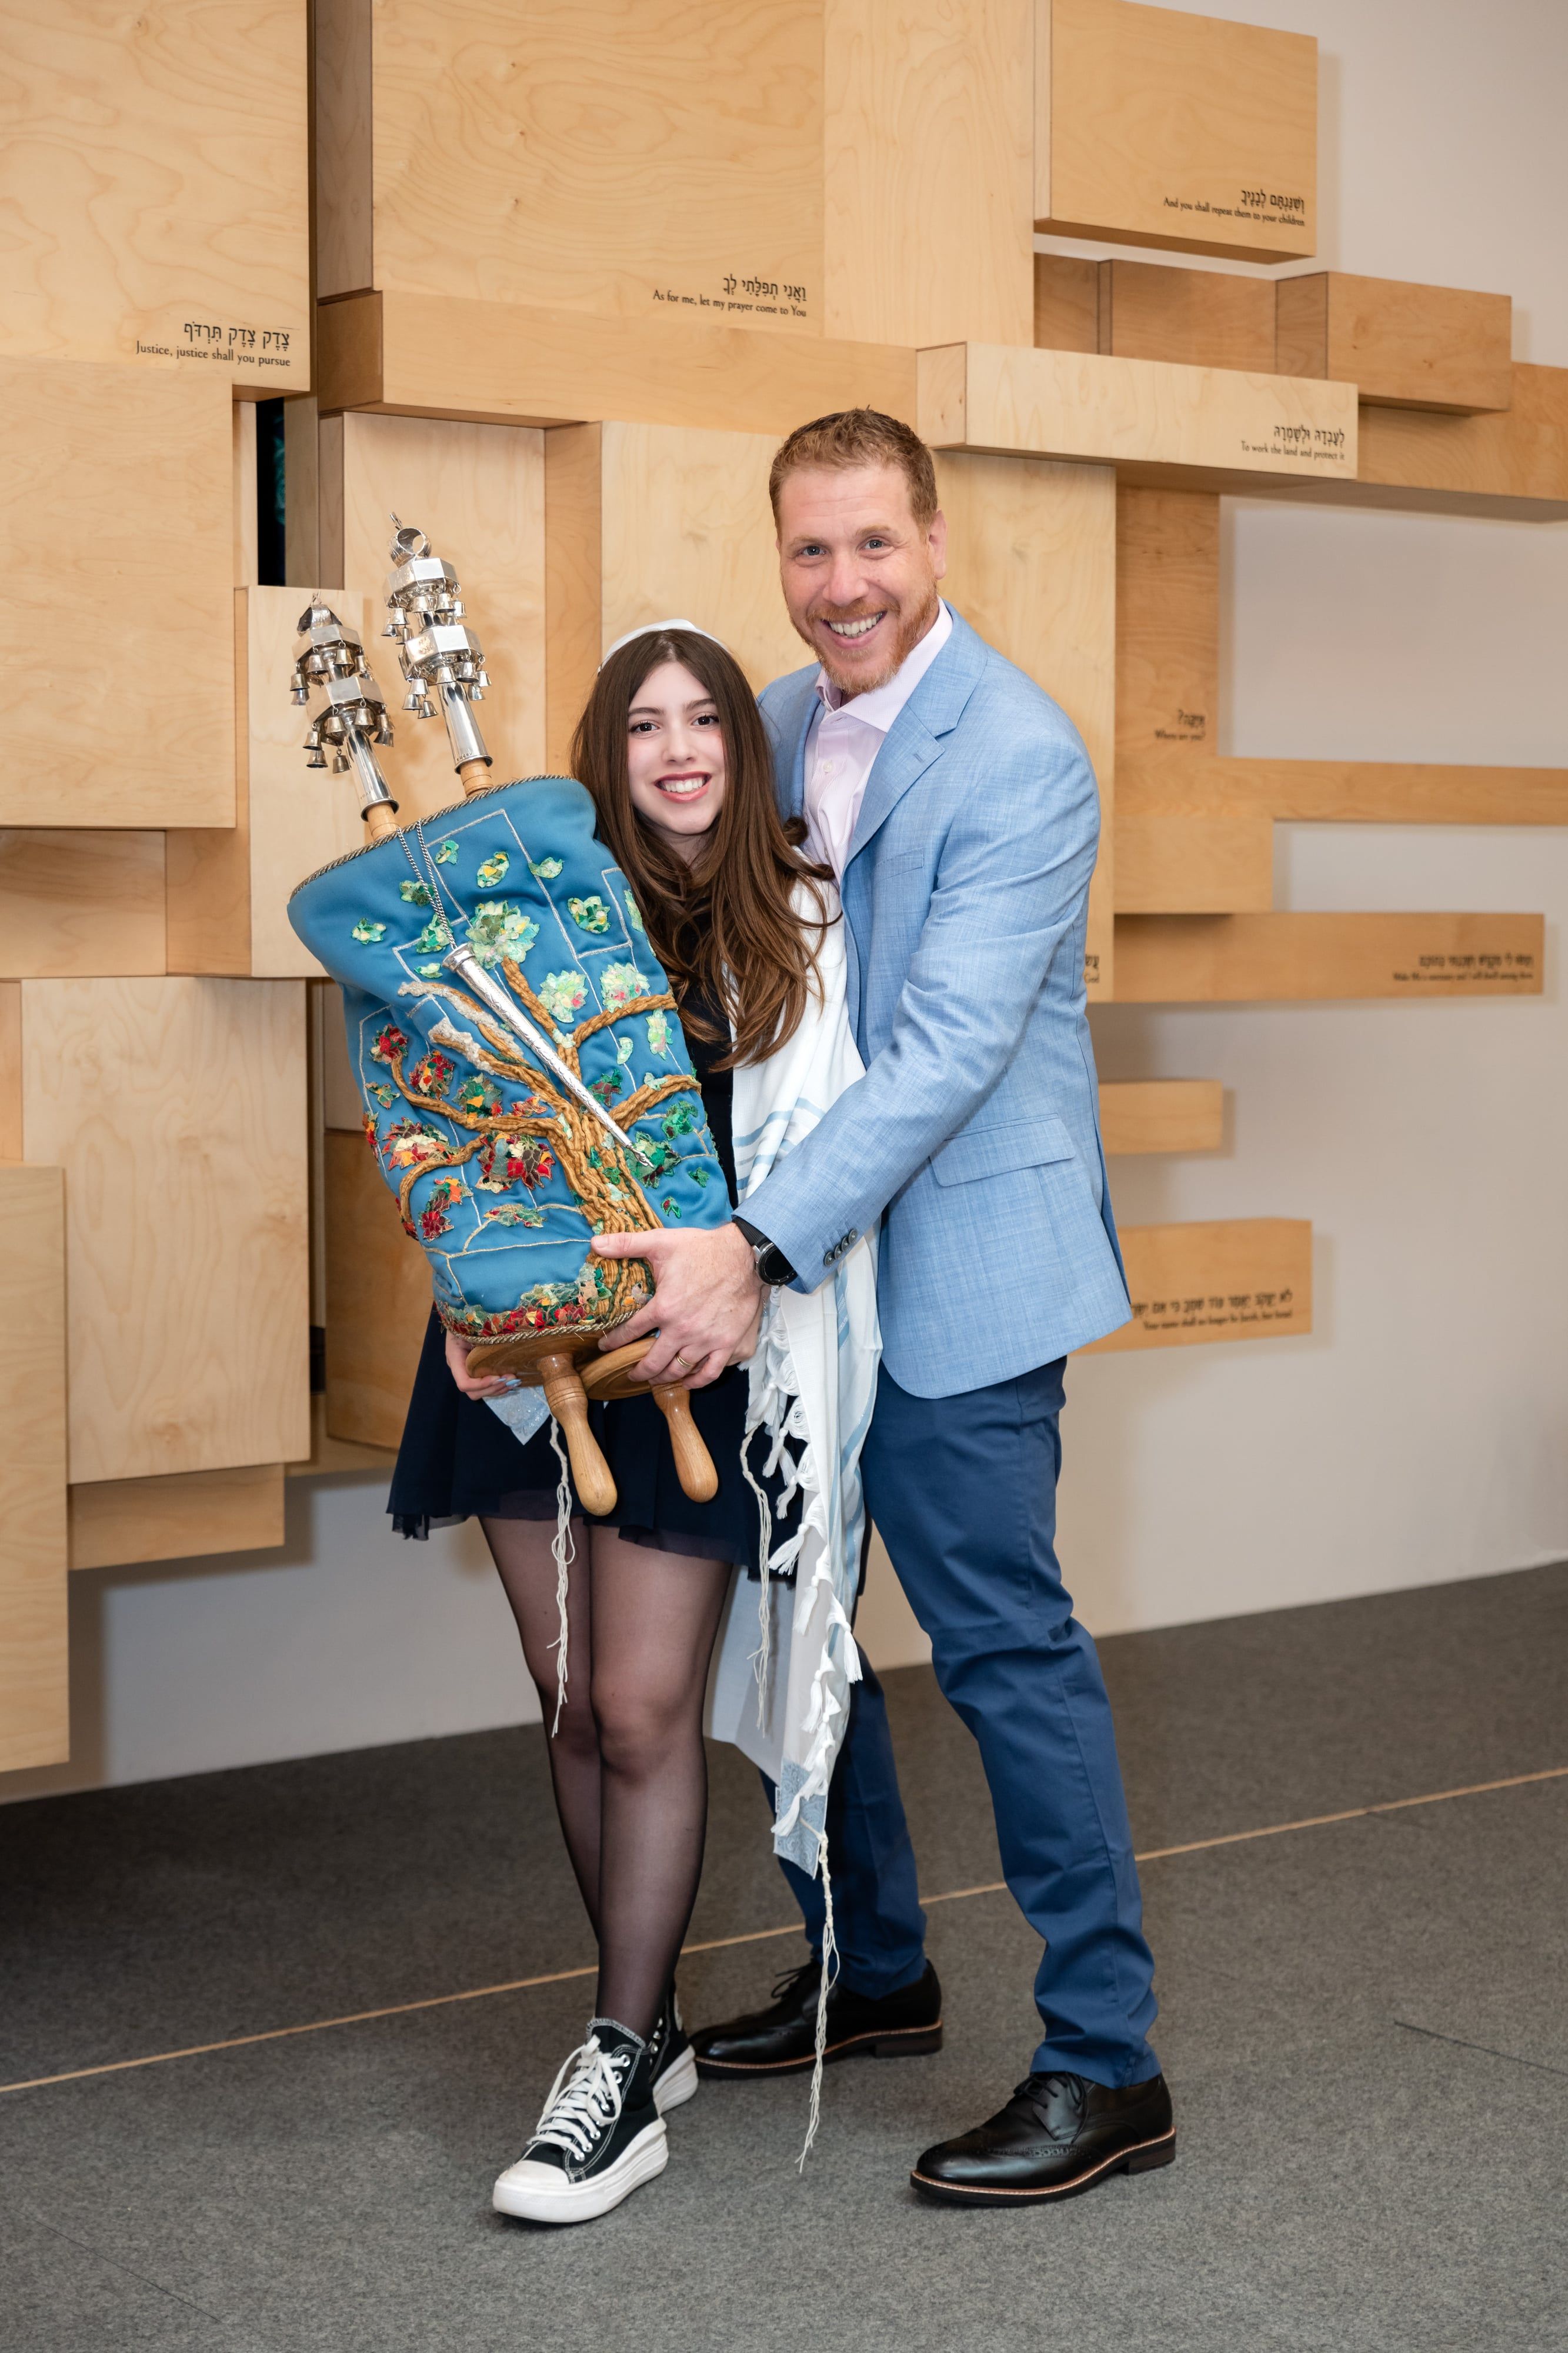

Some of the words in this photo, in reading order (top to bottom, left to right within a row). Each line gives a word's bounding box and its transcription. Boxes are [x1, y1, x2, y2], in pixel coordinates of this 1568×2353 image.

[1164, 197, 1178, 208] And
[1180, 202, 1192, 212] you
[1195, 201, 1210, 212] shall
[1212, 206, 1232, 216] repeat
[1234, 207, 1251, 219] them
[1263, 214, 1277, 224] your
[1279, 214, 1305, 226] children
[653, 290, 664, 301] As
[668, 290, 678, 302] for
[682, 296, 696, 306] me,
[700, 294, 709, 306] let
[713, 300, 725, 311] my
[728, 302, 753, 313] prayer
[756, 304, 777, 314] come
[780, 307, 788, 315] to
[791, 305, 806, 317] You
[136, 341, 172, 356] Justice,
[176, 348, 208, 359] justice
[212, 348, 233, 361] shall
[238, 354, 255, 365] you
[259, 356, 291, 367] pursue
[1242, 441, 1250, 451] To
[1252, 442, 1268, 453] work
[1271, 443, 1281, 454] the
[1283, 444, 1297, 456] land
[1300, 447, 1312, 457] and
[1314, 451, 1337, 461] protect
